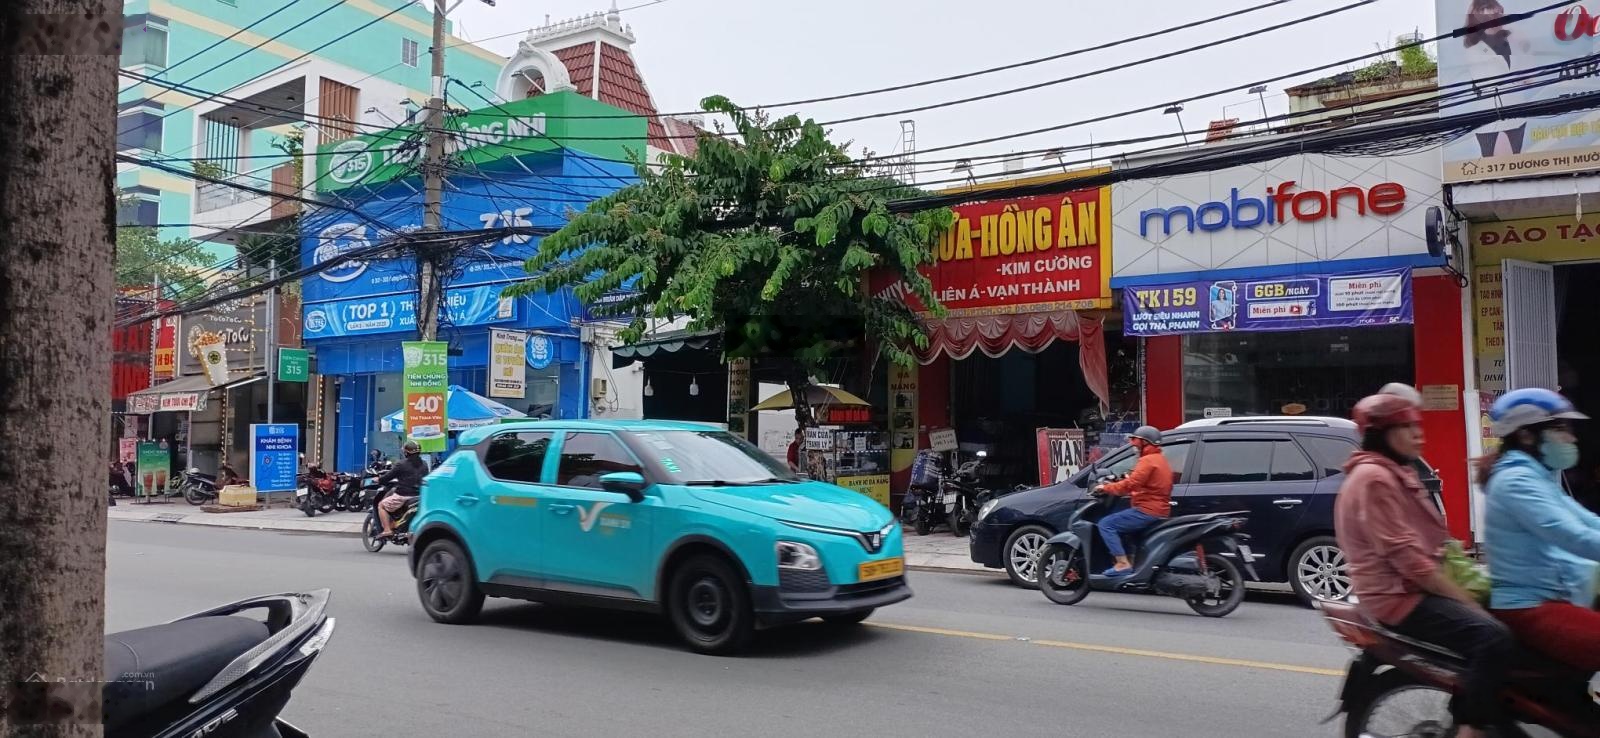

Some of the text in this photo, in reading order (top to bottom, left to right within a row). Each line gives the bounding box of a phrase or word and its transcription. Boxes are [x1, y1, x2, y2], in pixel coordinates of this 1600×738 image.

[507, 112, 546, 142] NHI
[1487, 164, 1506, 173] 317
[1509, 158, 1550, 171] DƯƠNG
[1553, 156, 1570, 167] THỊ
[1140, 180, 1407, 238] mobifone
[1057, 196, 1097, 248] ÂN
[1479, 223, 1600, 246] ĐÀO TẠ
[1021, 278, 1081, 295] THÀNH
[1136, 287, 1197, 308] TK159
[348, 303, 377, 320] TOP
[1172, 310, 1200, 319] NHANH
[1133, 322, 1148, 331] GỌI
[1168, 321, 1200, 330] PHANH
[422, 353, 447, 366] 315
[286, 364, 302, 375] 315
